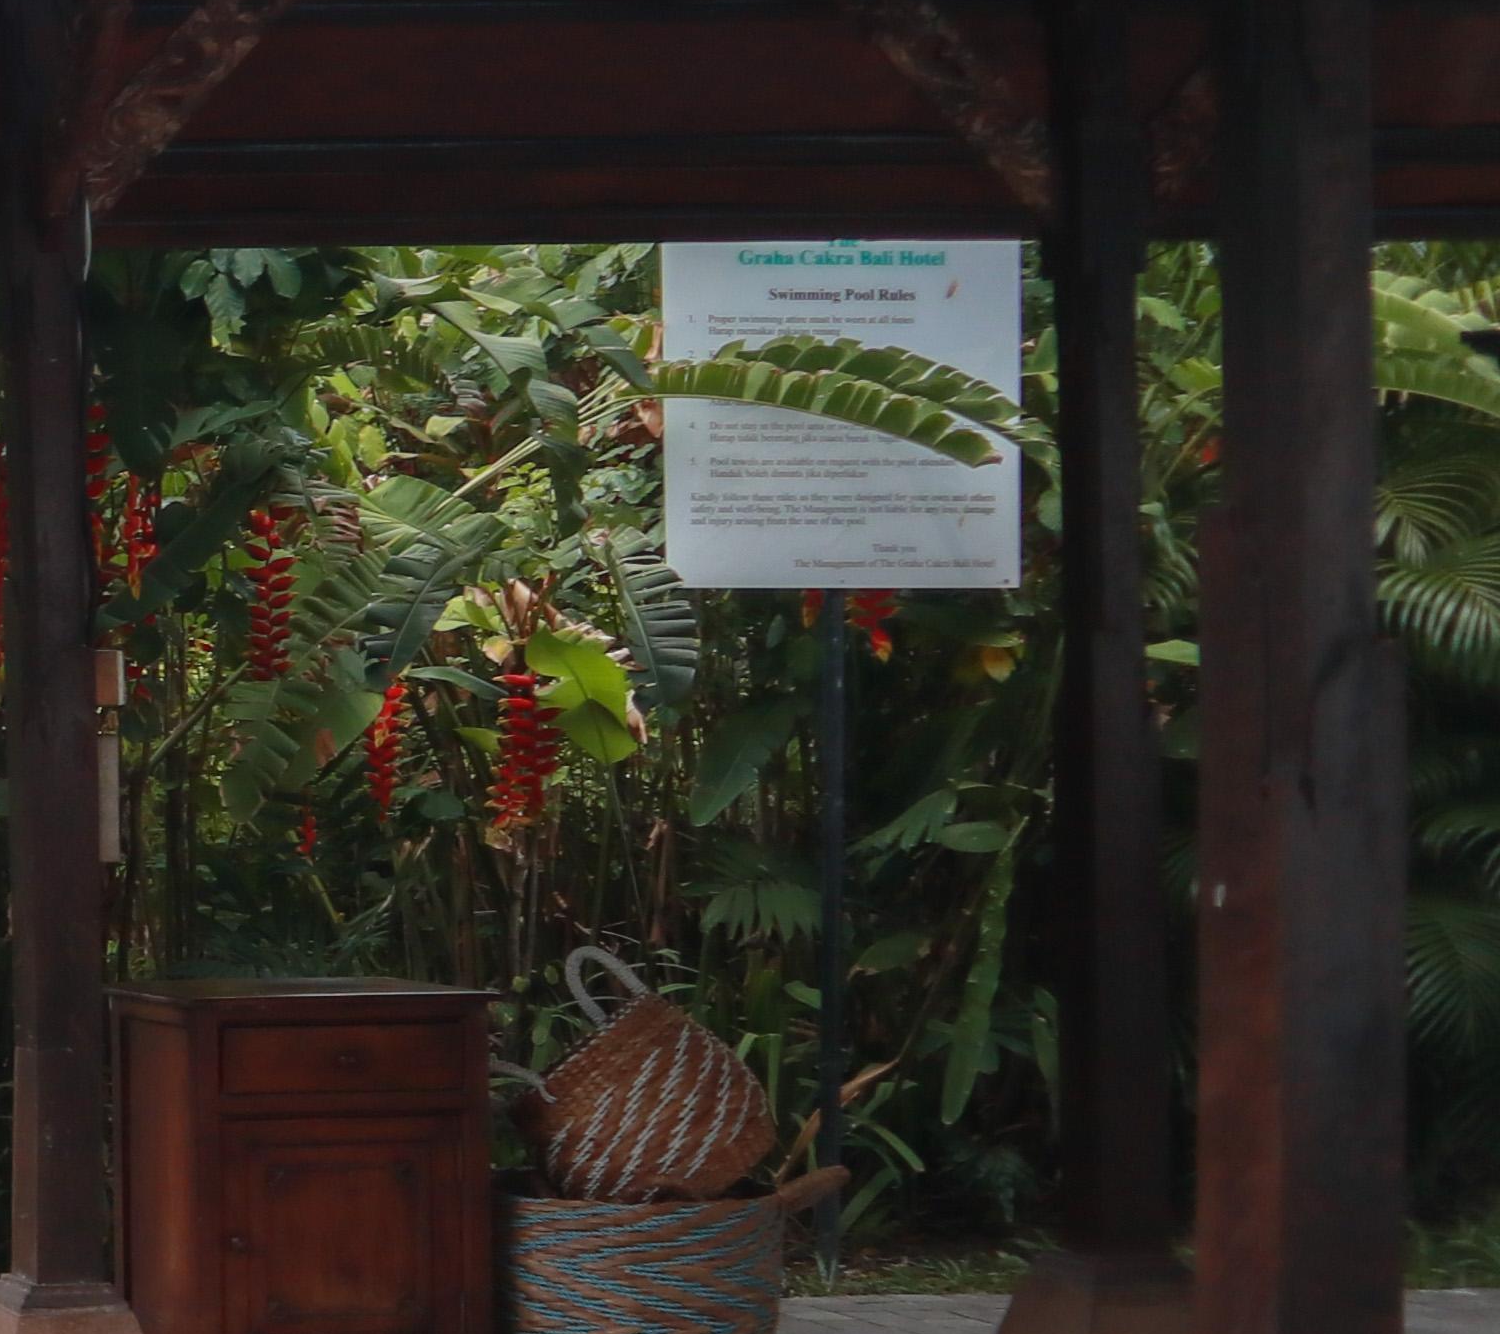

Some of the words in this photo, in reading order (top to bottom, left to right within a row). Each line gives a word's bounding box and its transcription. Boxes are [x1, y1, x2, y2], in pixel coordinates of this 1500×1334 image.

[739, 250, 794, 265] Graha
[799, 250, 855, 265] Cakra
[860, 250, 893, 265] Bali
[899, 250, 945, 265] Hotel
[768, 288, 841, 303] Swimming
[844, 288, 875, 301] Pool
[878, 288, 916, 301] Rules
